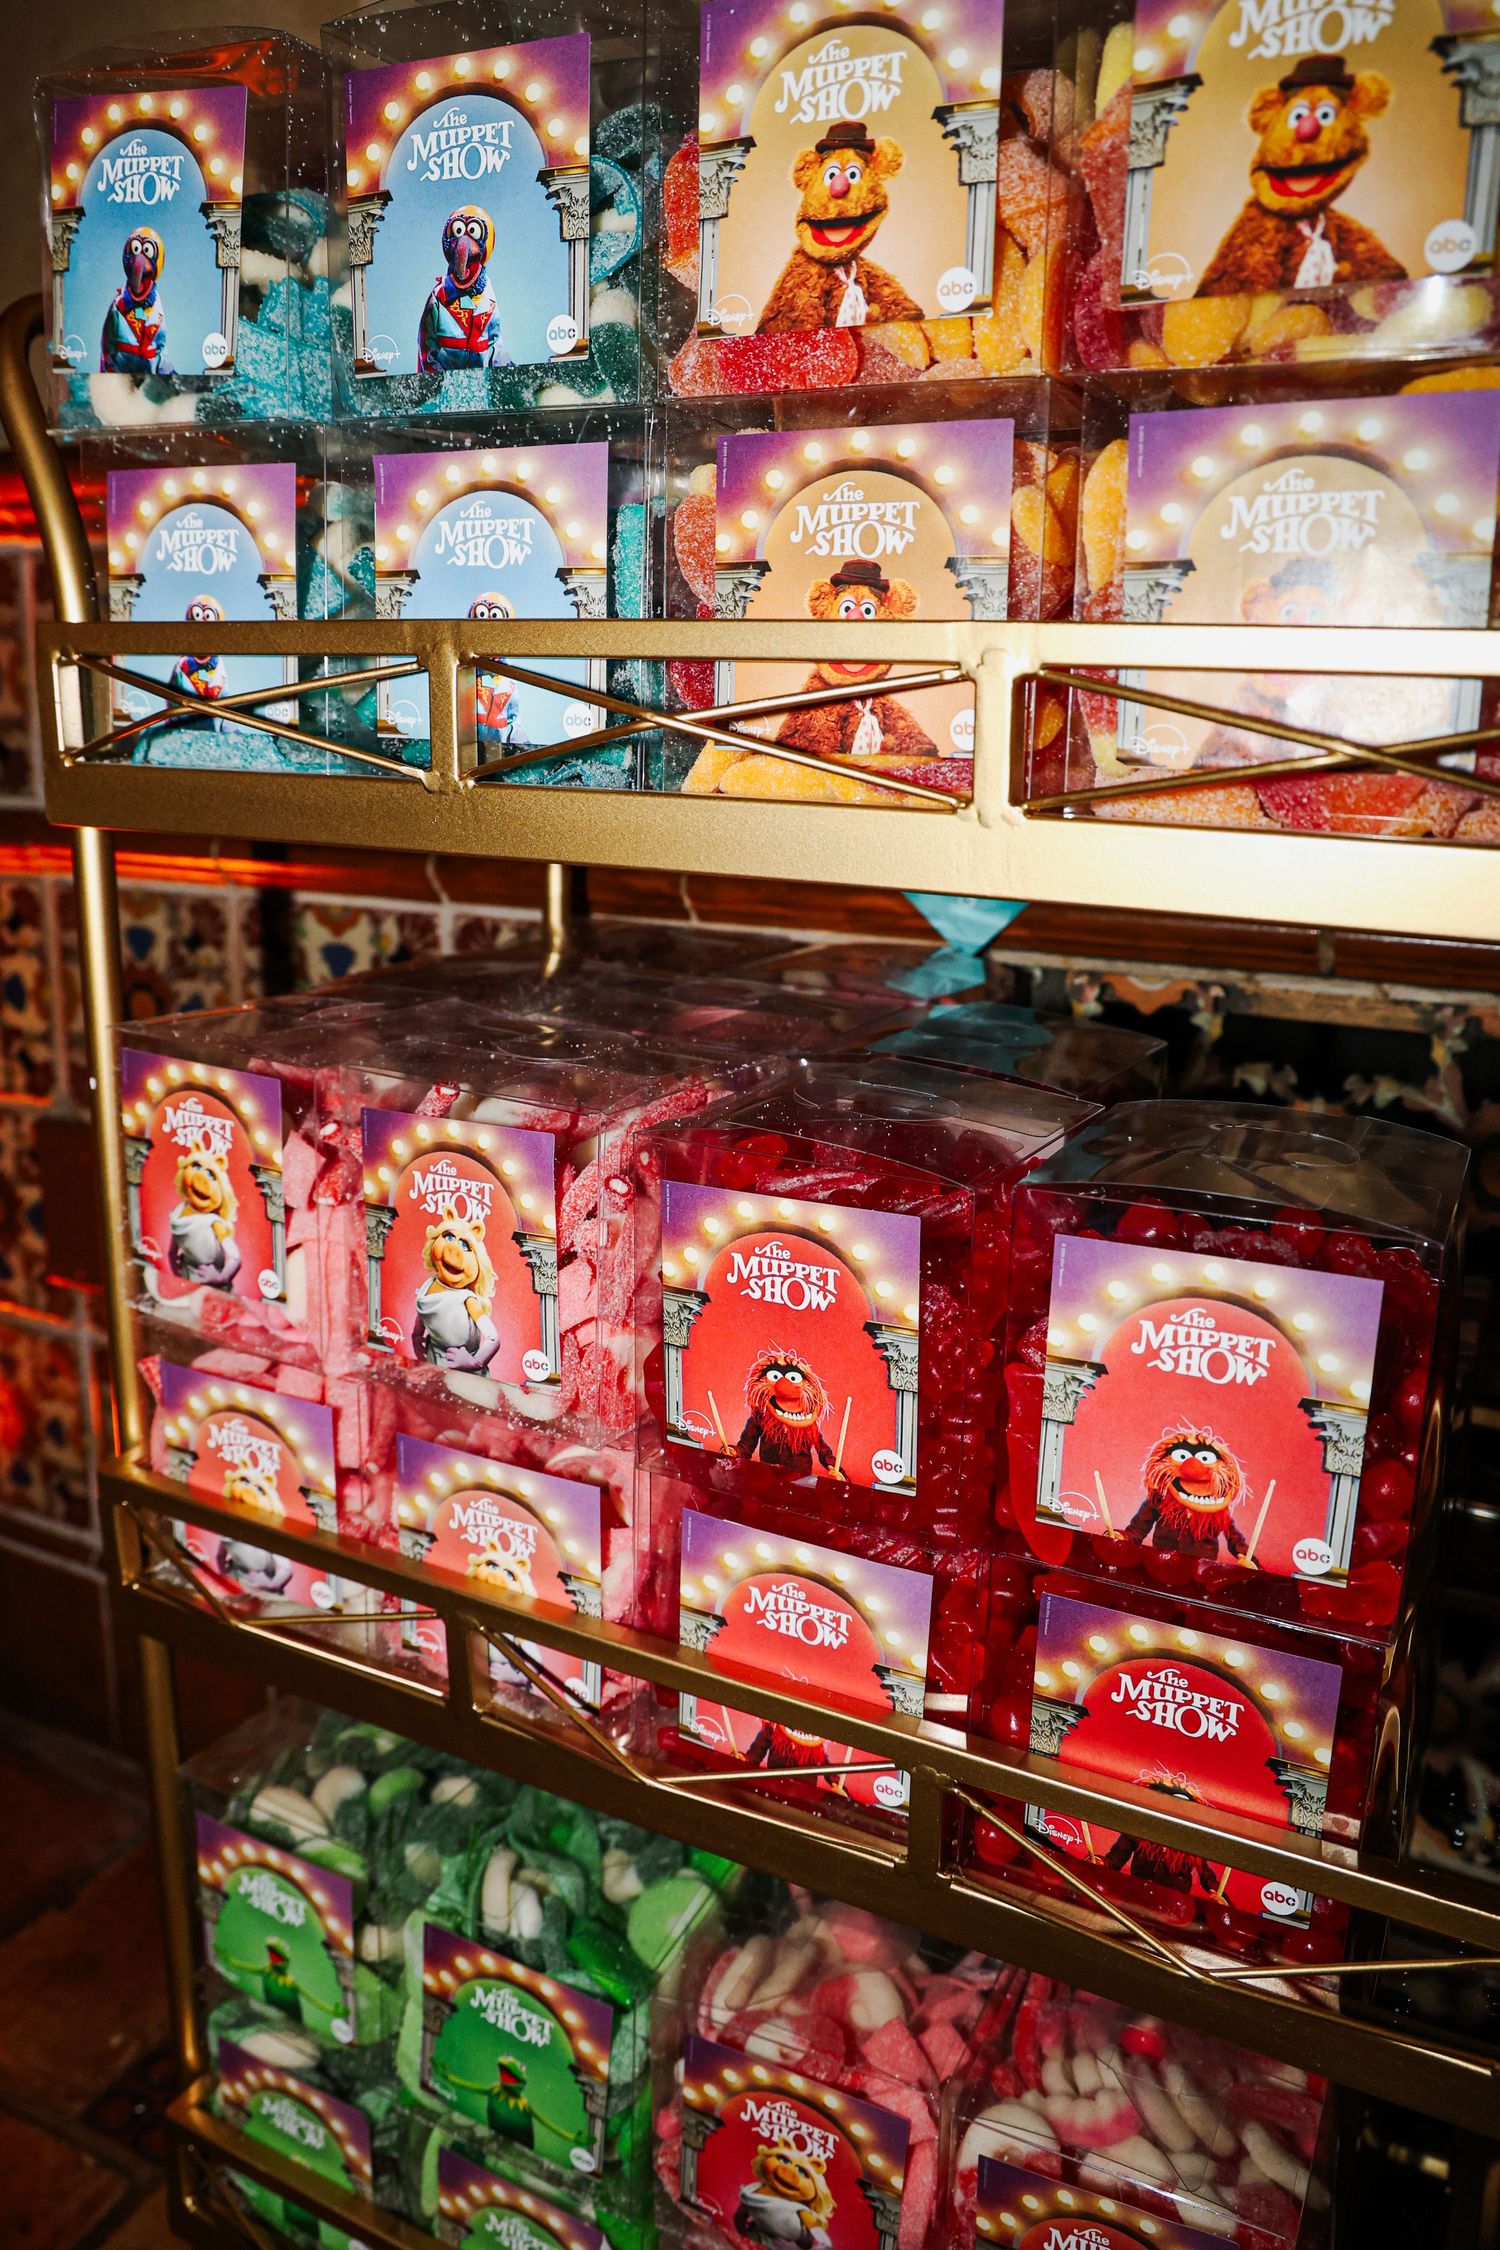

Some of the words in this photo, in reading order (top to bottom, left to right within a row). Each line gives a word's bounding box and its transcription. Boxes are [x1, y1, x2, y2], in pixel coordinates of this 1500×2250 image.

[1247, 5, 1392, 60] SHOW
[808, 39, 850, 64] The
[774, 51, 908, 114] MUPPET
[790, 77, 902, 124] SHOW
[433, 106, 468, 128] The
[120, 138, 148, 157] The
[406, 120, 515, 171] MUPPET
[97, 155, 184, 192] MUPPET
[420, 142, 511, 181] SHOW
[107, 171, 180, 206] SHOW
[940, 281, 973, 295] abc
[549, 327, 575, 340] abc
[204, 344, 226, 355] abc
[823, 481, 864, 502] The
[1262, 467, 1315, 492] The
[176, 512, 203, 528] The
[460, 501, 492, 518] The
[790, 501, 920, 543] MUPPET
[1220, 490, 1386, 540] MUPPET
[156, 529, 239, 560] MUPPET
[435, 518, 536, 554] MUPPET
[805, 520, 914, 559] SHOW
[1239, 511, 1376, 557] SHOW
[166, 544, 237, 575] SHOW
[446, 534, 532, 569] SHOW
[566, 713, 591, 727] abc
[429, 1159, 457, 1175] The
[409, 1170, 494, 1207] MUPPET
[755, 1241, 791, 1259] The
[727, 1252, 840, 1294] MUPPET
[740, 1276, 836, 1311] SHOW
[1170, 1308, 1216, 1328] The
[1131, 1320, 1276, 1367] MUPPET
[525, 1359, 548, 1371] abc
[1146, 1347, 1267, 1386] SHOW
[874, 1460, 903, 1474] abc
[1296, 1549, 1330, 1564] abc
[772, 1582, 806, 1600] The
[744, 1586, 853, 1637] MUPPET
[756, 1610, 847, 1649] SHOW
[1147, 1668, 1188, 1687] The
[1111, 1673, 1244, 1728] MUPPET
[1126, 1701, 1236, 1742] SHOW
[876, 1784, 903, 1799] abc
[1264, 1890, 1296, 1907] abc
[767, 2101, 798, 2118] The
[740, 2099, 840, 2154] MUPPET
[1073, 2228, 1110, 2246] The
